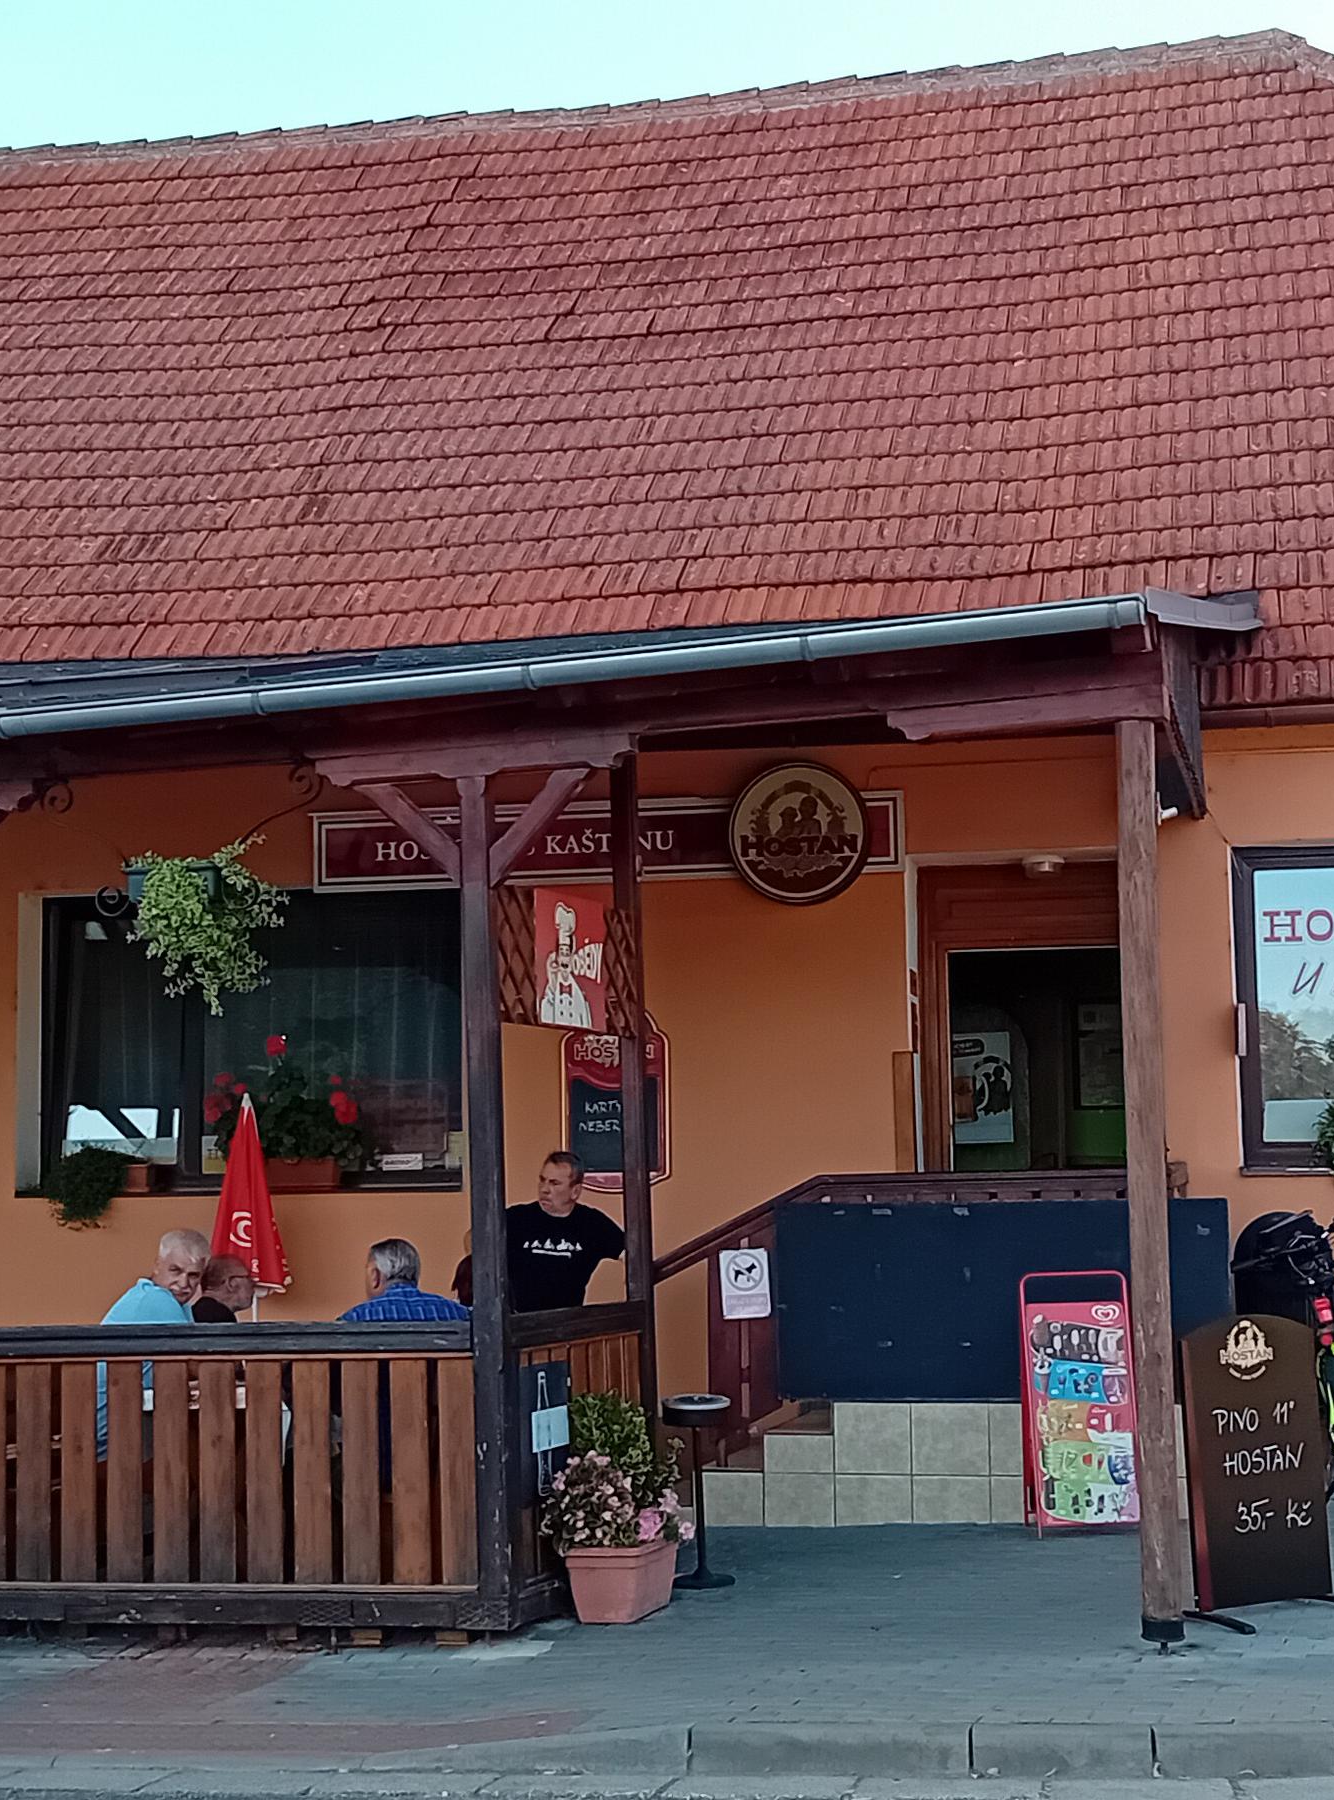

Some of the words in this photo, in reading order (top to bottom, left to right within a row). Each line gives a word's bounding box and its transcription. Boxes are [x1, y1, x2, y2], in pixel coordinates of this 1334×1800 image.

[545, 828, 674, 855] KAŠTNU
[740, 834, 858, 857] HOSTAN
[1292, 961, 1325, 995] U
[578, 1119, 622, 1133] NEBER
[1220, 1348, 1273, 1364] HOSTAN
[1212, 1407, 1259, 1435] PIVO
[1223, 1442, 1305, 1477] HOSTAN
[1286, 1498, 1312, 1529] Kč
